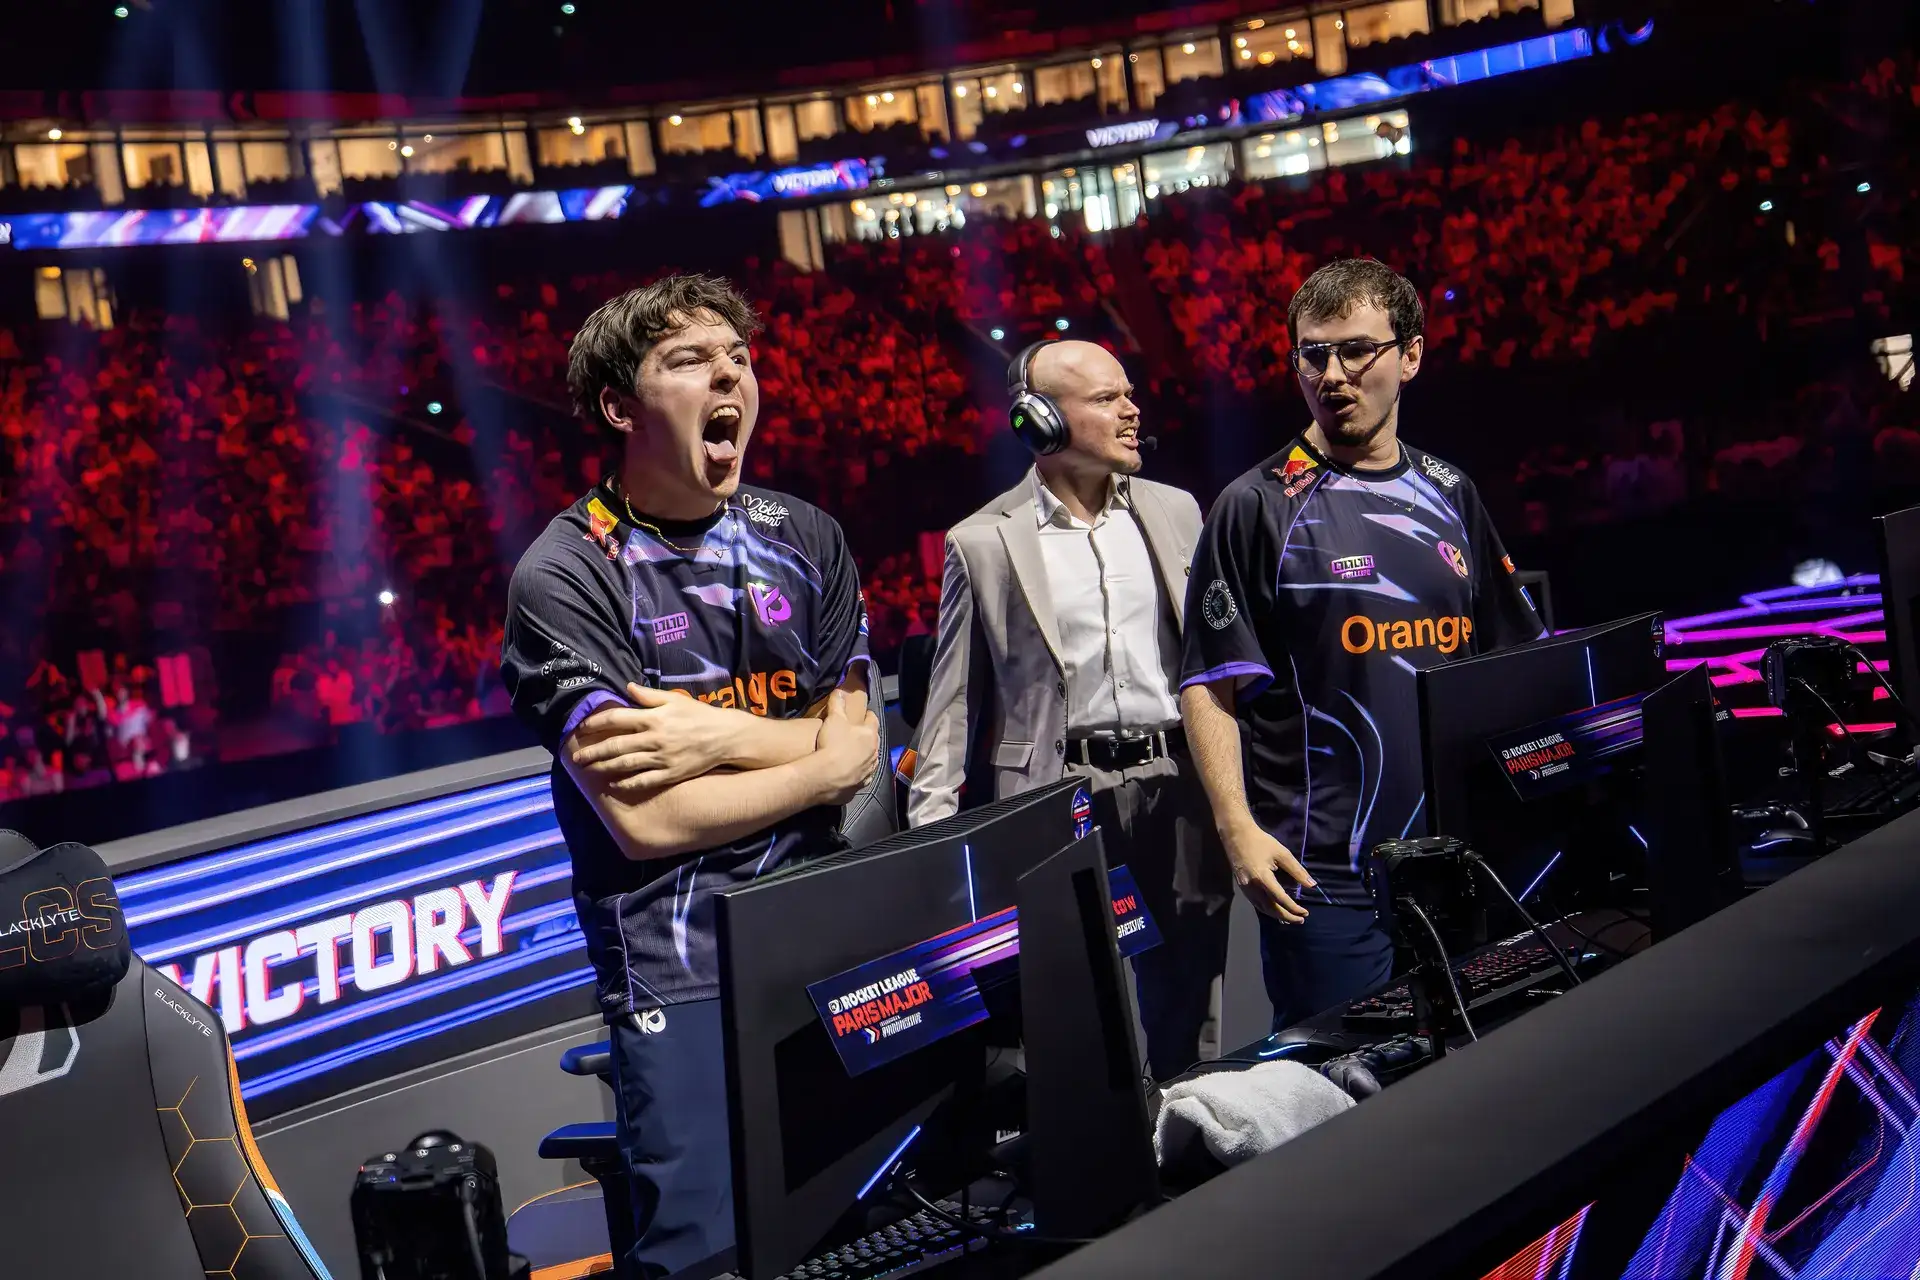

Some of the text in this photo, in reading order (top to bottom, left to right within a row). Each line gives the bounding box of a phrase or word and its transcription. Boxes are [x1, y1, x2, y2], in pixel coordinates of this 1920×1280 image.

[1086, 119, 1159, 148] VICTORY
[773, 168, 840, 193] VICTORY
[758, 500, 789, 515] blue
[1510, 733, 1564, 757] ROCKET LEAGUE
[0, 909, 80, 937] LACKLYTE
[840, 968, 920, 1010] ROCKET LEAGUE
[155, 988, 212, 1038] BLACKLYTE
[832, 981, 933, 1037] PARIS MAJOR
